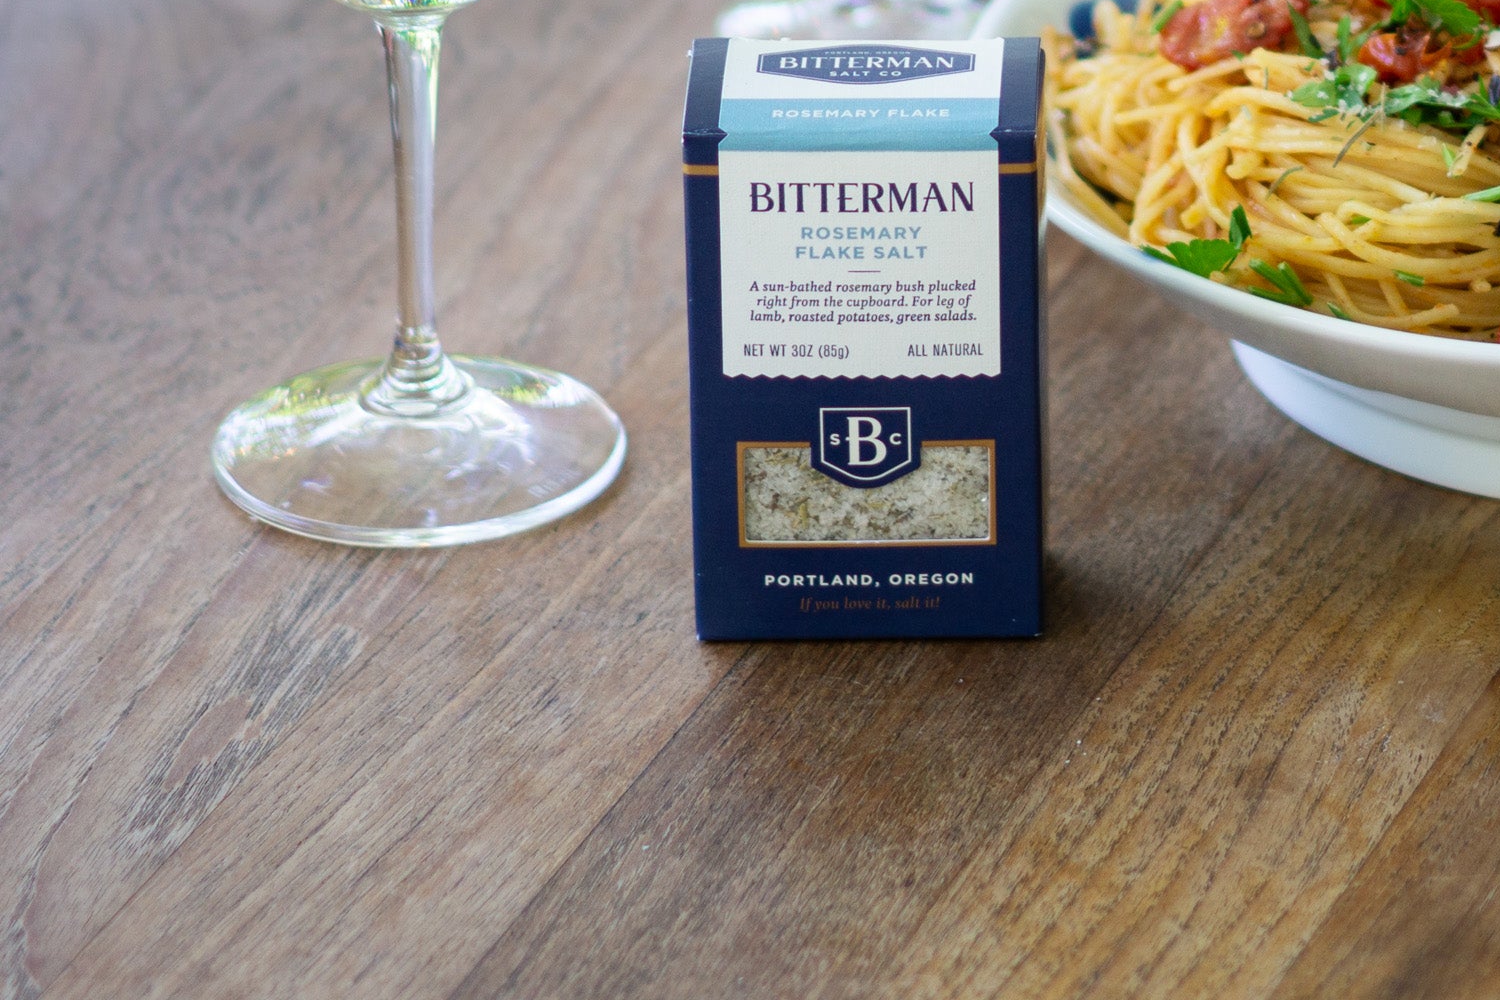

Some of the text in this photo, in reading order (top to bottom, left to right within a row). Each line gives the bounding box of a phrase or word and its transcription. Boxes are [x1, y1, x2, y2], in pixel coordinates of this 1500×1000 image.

[779, 56, 954, 69] BITTERMAN
[772, 109, 950, 118] ROSEMARY FLAKE
[749, 181, 975, 214] BITTERMAN
[800, 226, 922, 240] ROSEMARY
[795, 246, 928, 260] FLAKE SALT
[750, 279, 976, 295] A sun-bathed rosemary bush plucked
[756, 294, 972, 309] right from the cupboard. For leg of
[750, 309, 977, 325] lamb, roasted potatoes, green salads.
[743, 344, 764, 357] NET
[769, 344, 787, 357] WT
[818, 344, 850, 360] (85g)
[907, 343, 984, 357] ALL NATURAL
[829, 416, 902, 466] S B C
[764, 573, 974, 587] PORTLAND, OREGON
[800, 596, 940, 612] If you love it, salt it!
